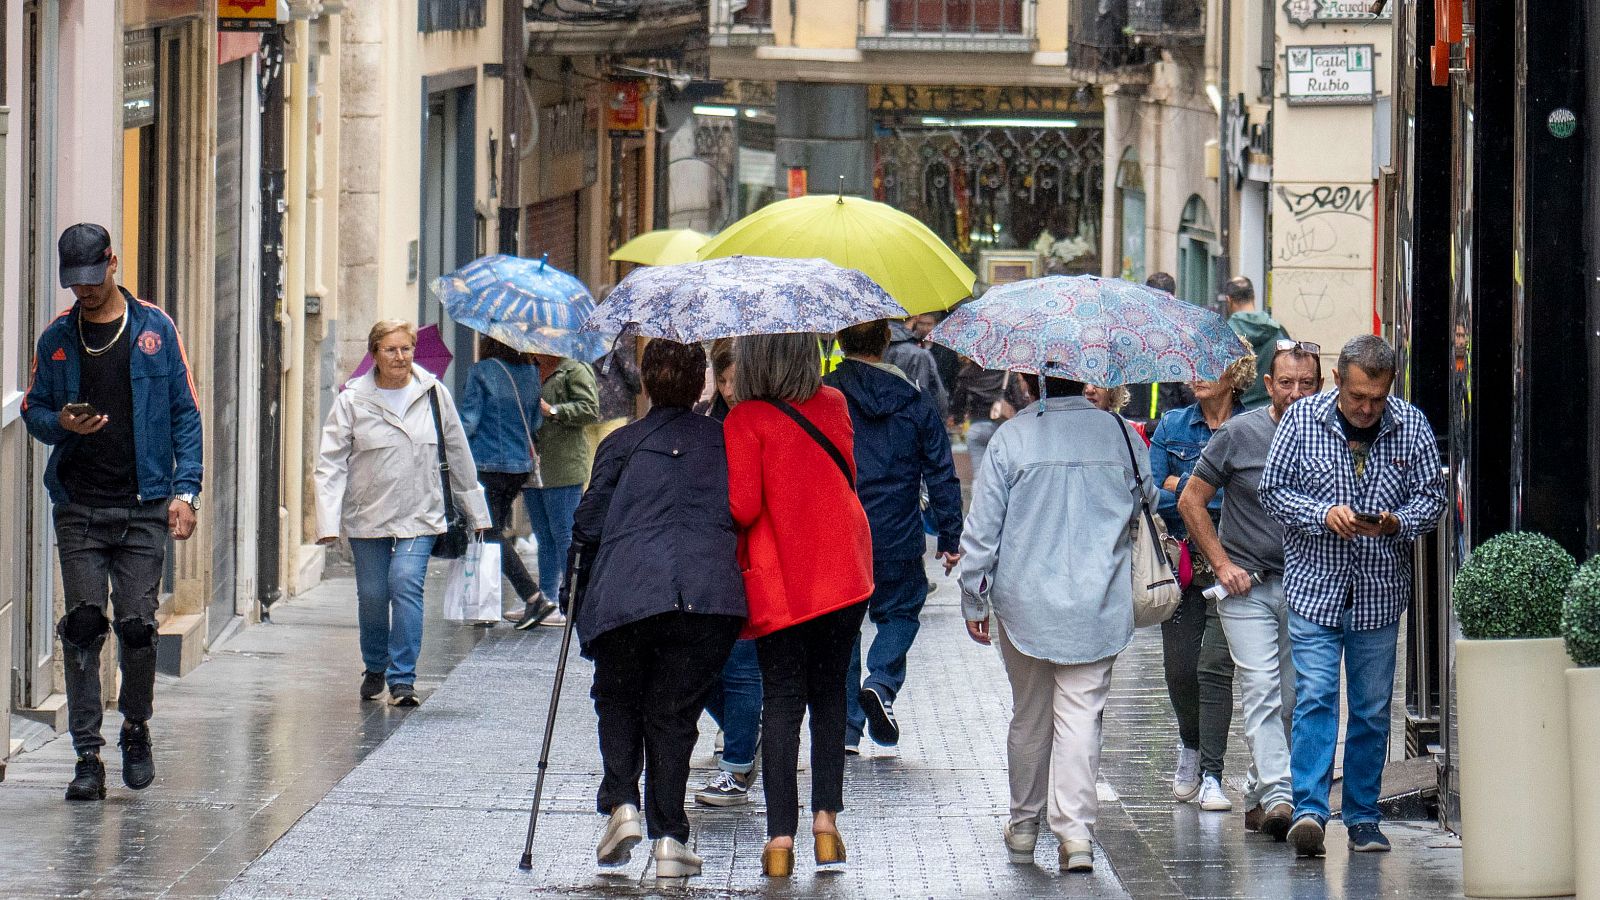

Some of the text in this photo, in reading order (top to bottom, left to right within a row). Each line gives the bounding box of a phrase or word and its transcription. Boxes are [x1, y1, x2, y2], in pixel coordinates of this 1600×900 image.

[1315, 56, 1346, 68] Calle
[1322, 68, 1337, 77] de
[1307, 78, 1350, 92] Rubio
